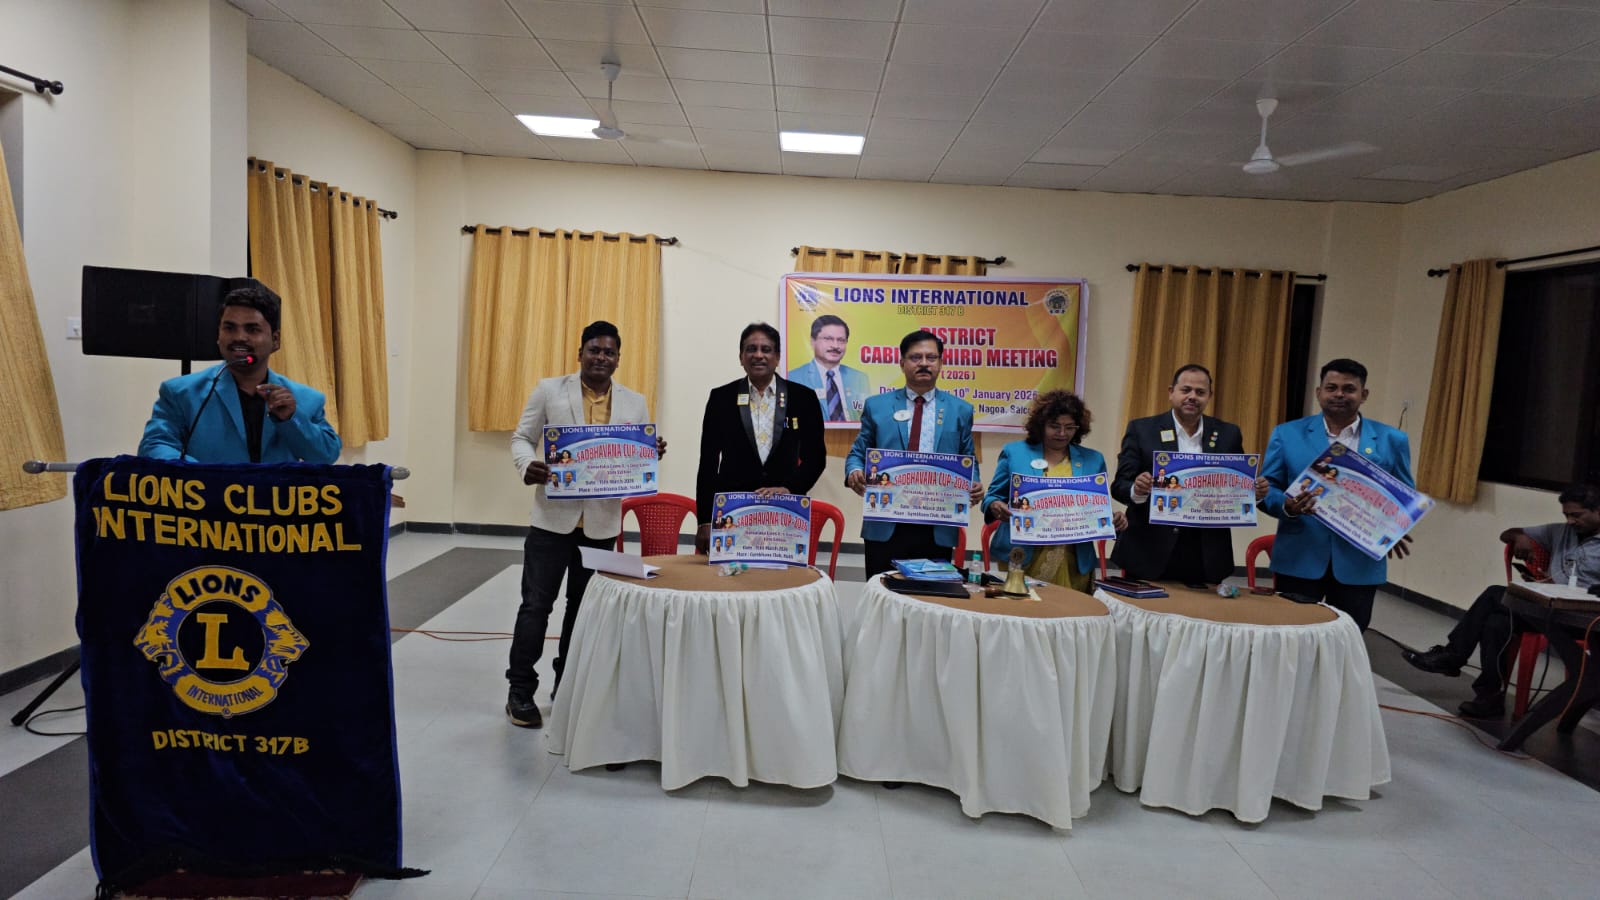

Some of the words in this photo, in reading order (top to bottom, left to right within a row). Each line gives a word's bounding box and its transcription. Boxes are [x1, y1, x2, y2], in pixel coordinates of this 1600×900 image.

[834, 287, 885, 303] LIONS
[891, 288, 1029, 306] INTERNATIONAL
[897, 305, 937, 316] DISTRICT
[939, 305, 955, 317] 317
[957, 306, 965, 316] B
[920, 327, 996, 346] ISTRICT
[860, 345, 901, 364] CABI
[942, 348, 983, 367] HIRD
[986, 349, 1057, 368] MEETING
[972, 389, 1011, 401] January
[562, 426, 583, 434] LIONS
[585, 425, 641, 433] INTERNATIONAL
[576, 442, 622, 463] SADBHAVANA
[905, 452, 959, 462] INTERNATIONAL
[1195, 454, 1246, 462] INTERNATIONAL
[894, 471, 937, 486] SADBHAVANA
[1183, 472, 1228, 489] SADBHAVANA
[103, 471, 206, 511] LIONS
[223, 484, 343, 516] CLUBS
[1033, 494, 1075, 510] SADBHAVANA
[736, 511, 779, 528] SADBHAVANA
[93, 506, 362, 553] INTERNATIONAL
[174, 574, 261, 605] LIONS
[195, 612, 250, 671] L
[186, 684, 264, 707] INTERNATIONAL
[152, 729, 247, 752] DISTRICT
[254, 736, 310, 755] 317B
